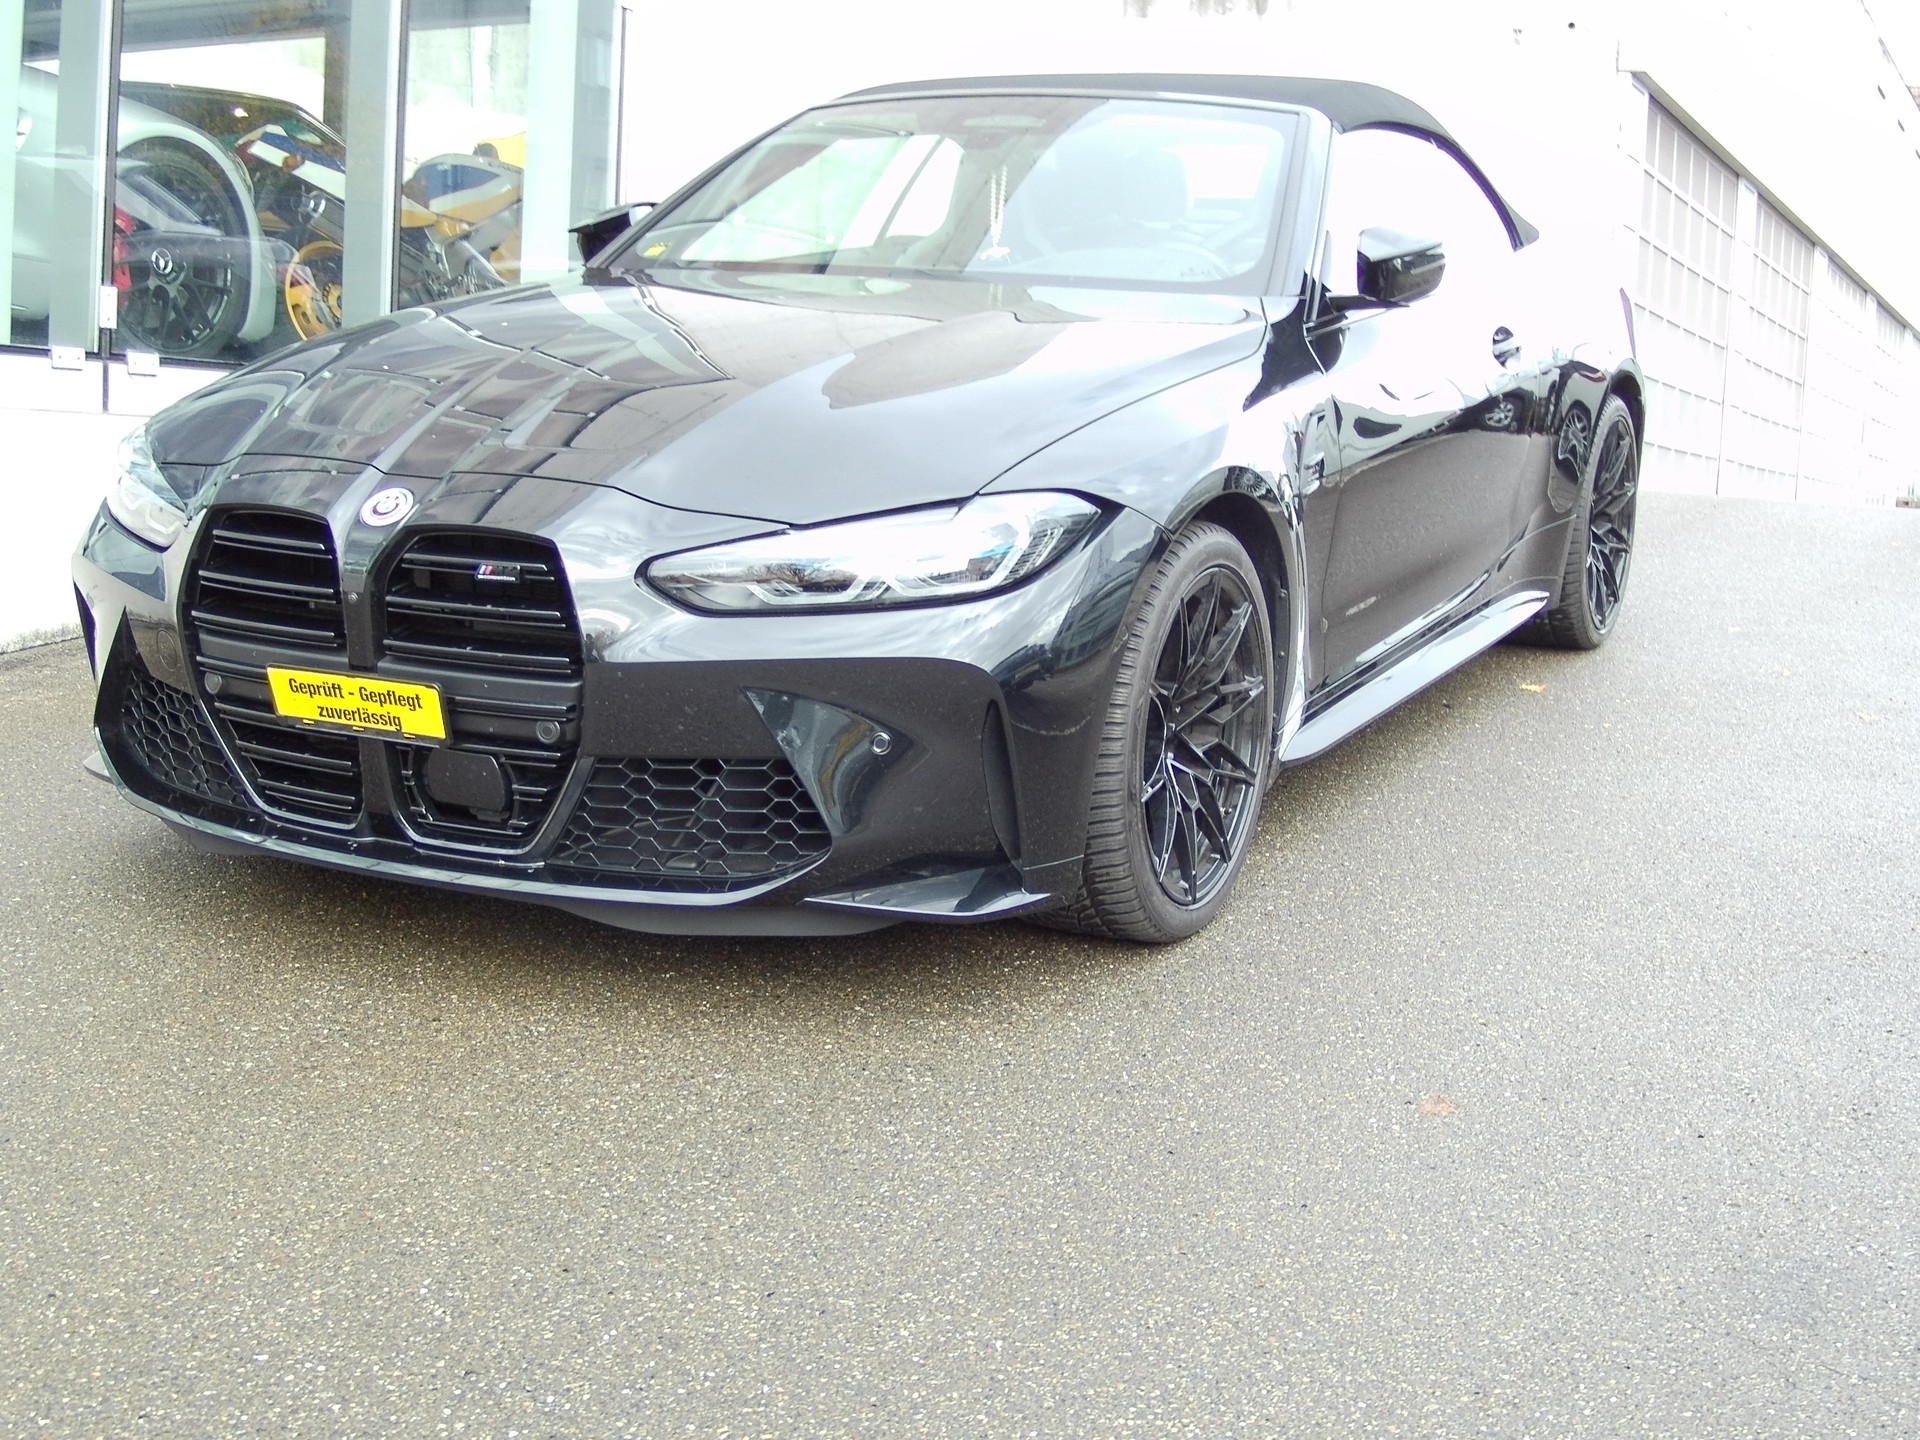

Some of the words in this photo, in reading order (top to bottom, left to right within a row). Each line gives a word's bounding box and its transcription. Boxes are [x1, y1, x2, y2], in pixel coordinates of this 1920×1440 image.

[288, 678, 344, 698] Geprüft
[359, 686, 423, 711] Gepflegt
[317, 705, 402, 731] zuverlässig
